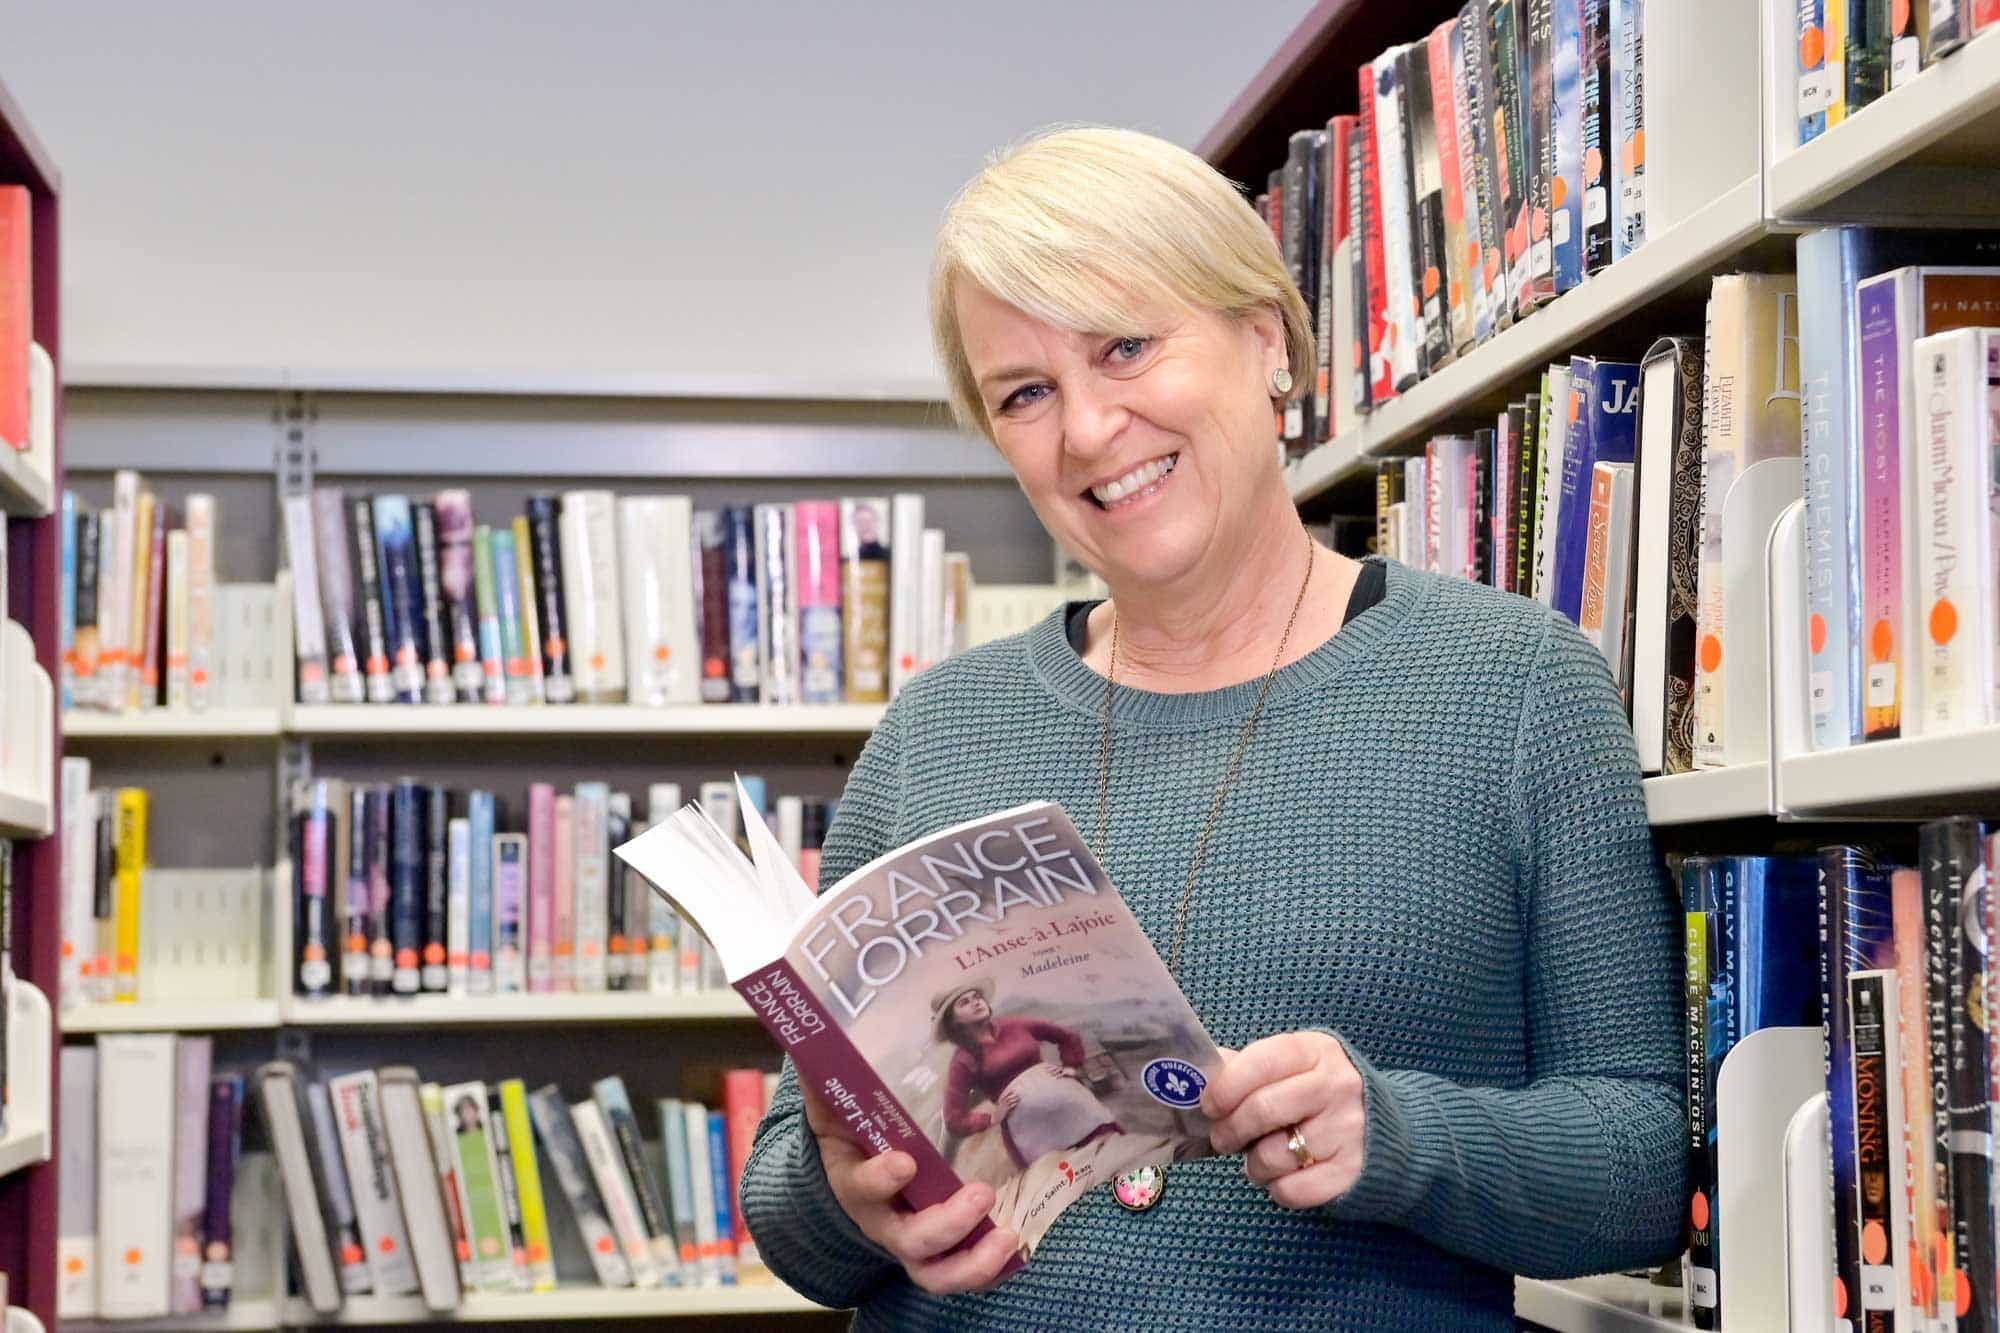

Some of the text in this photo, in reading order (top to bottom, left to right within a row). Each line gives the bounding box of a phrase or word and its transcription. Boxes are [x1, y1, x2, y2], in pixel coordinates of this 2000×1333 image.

[1462, 14, 1478, 87] HARPER
[1470, 97, 1480, 127] LEE
[1623, 20, 1633, 57] THE
[1633, 36, 1645, 65] THE
[1585, 68, 1600, 107] THE
[1540, 132, 1551, 171] THE
[1719, 375, 1735, 438] ELIZABETH
[1873, 353, 1887, 400] THE
[1873, 413, 1890, 480] HOST
[1517, 408, 1533, 581] LAURA LIPPMAN
[1809, 369, 1834, 608] THE CHEMIST
[799, 816, 1071, 981] FRANCE
[1724, 871, 1735, 941] GILLY
[1818, 868, 1828, 942] AFTER
[829, 856, 1097, 1018] LORRAIN
[954, 909, 1117, 971] L'Anse-à-Lajoie
[1020, 951, 1091, 978] Madeleine
[1820, 953, 1828, 982] THE
[1930, 889, 1946, 984] Secret
[1949, 859, 1965, 1072] THE STARLESS
[747, 980, 806, 1045] FRANCE
[767, 969, 826, 1035] LORRAIN
[1821, 992, 1833, 1077] FLOOD
[1687, 928, 1701, 1148] CLARE MACKINTOSH
[1857, 1056, 1877, 1163] MONING
[1930, 1000, 1949, 1151] HISTORY
[1030, 1199, 1046, 1217] Guy
